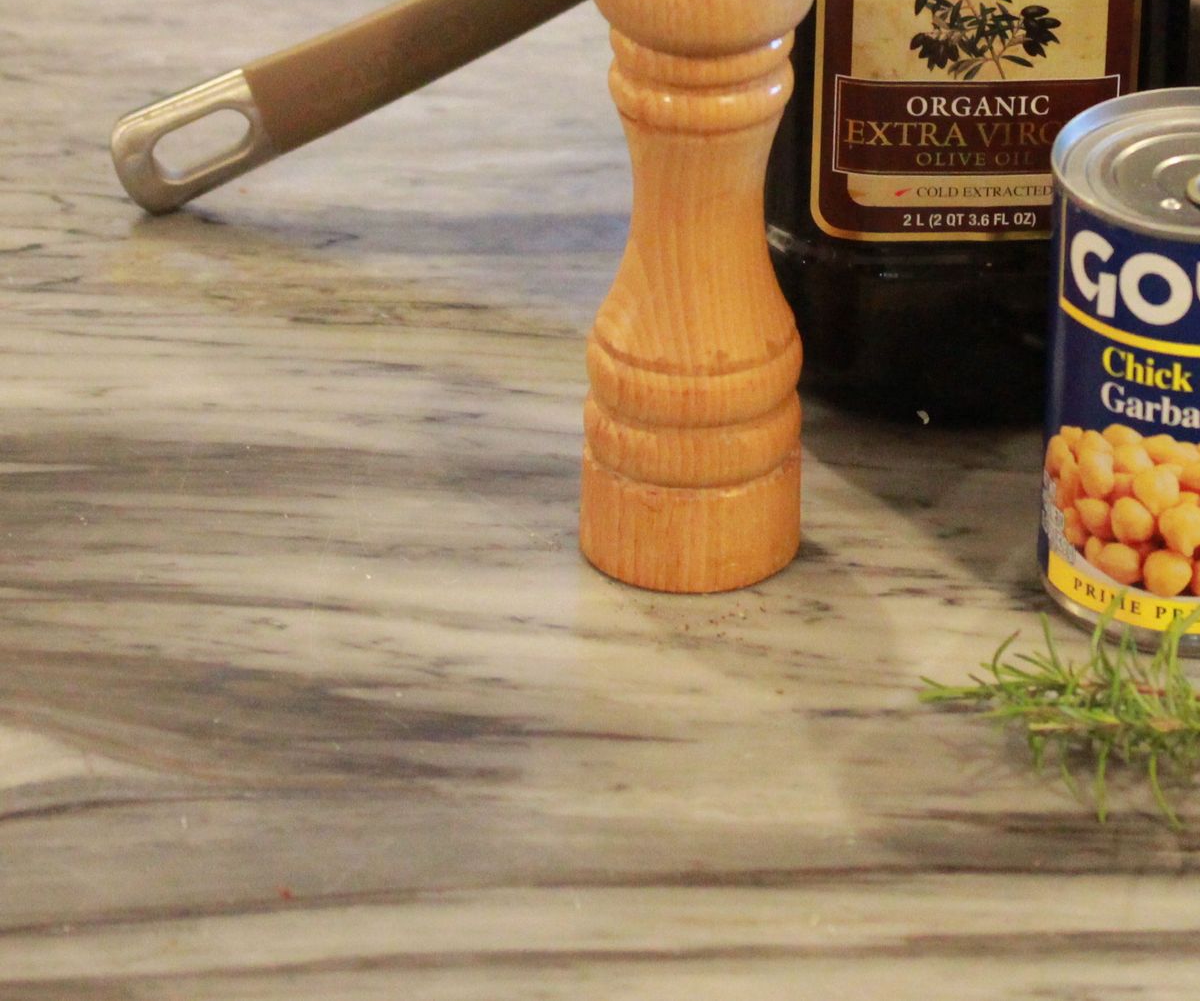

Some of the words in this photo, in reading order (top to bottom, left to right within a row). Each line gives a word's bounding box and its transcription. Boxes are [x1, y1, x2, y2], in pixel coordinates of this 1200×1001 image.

[906, 95, 1050, 117] ORGANIC
[844, 118, 968, 147] EXTRA
[916, 151, 986, 167] OLIVE
[995, 151, 1036, 167] OIL
[916, 186, 959, 198] COLD
[963, 185, 1053, 199] EXTRACTED
[903, 214, 912, 227] 2
[916, 214, 925, 227] L
[929, 213, 942, 228] (2
[946, 213, 965, 226] QT
[968, 213, 990, 226] 3.6
[994, 212, 1009, 226] FL
[1014, 212, 1037, 227] OZ)
[1101, 345, 1193, 393] Chick
